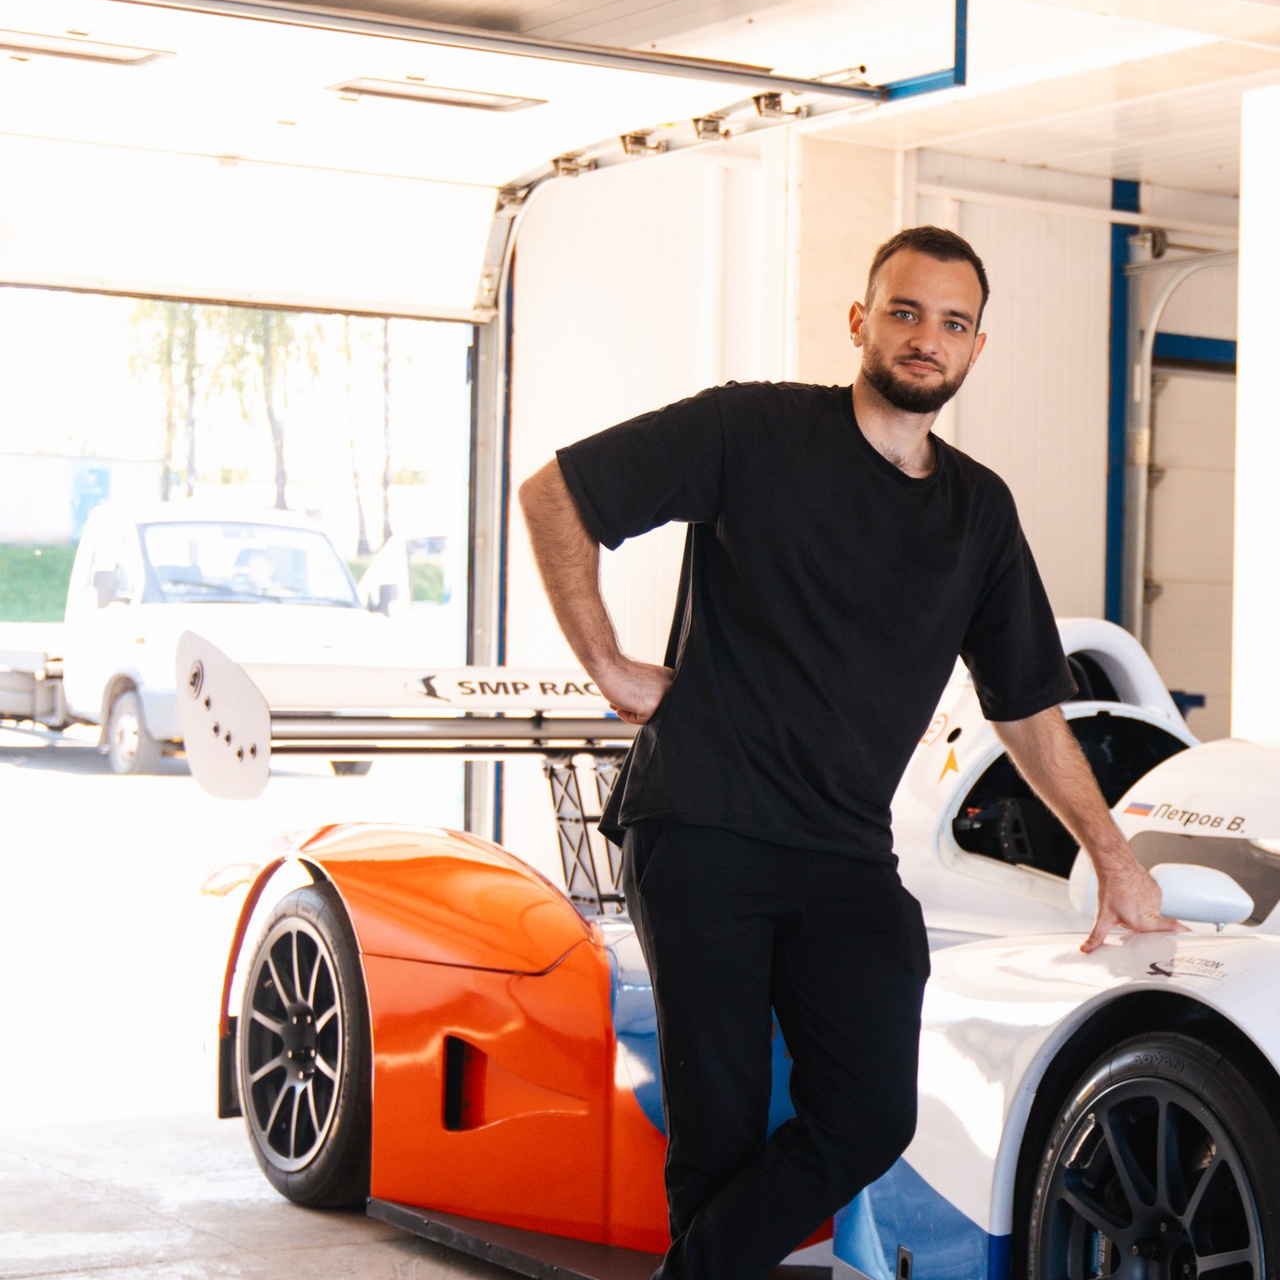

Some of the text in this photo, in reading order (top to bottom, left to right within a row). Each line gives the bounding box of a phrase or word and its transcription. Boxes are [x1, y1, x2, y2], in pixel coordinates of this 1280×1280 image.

[457, 681, 530, 696] SMP
[1153, 803, 1246, 834] Петров В.
[1132, 1053, 1186, 1072] ADVAN
